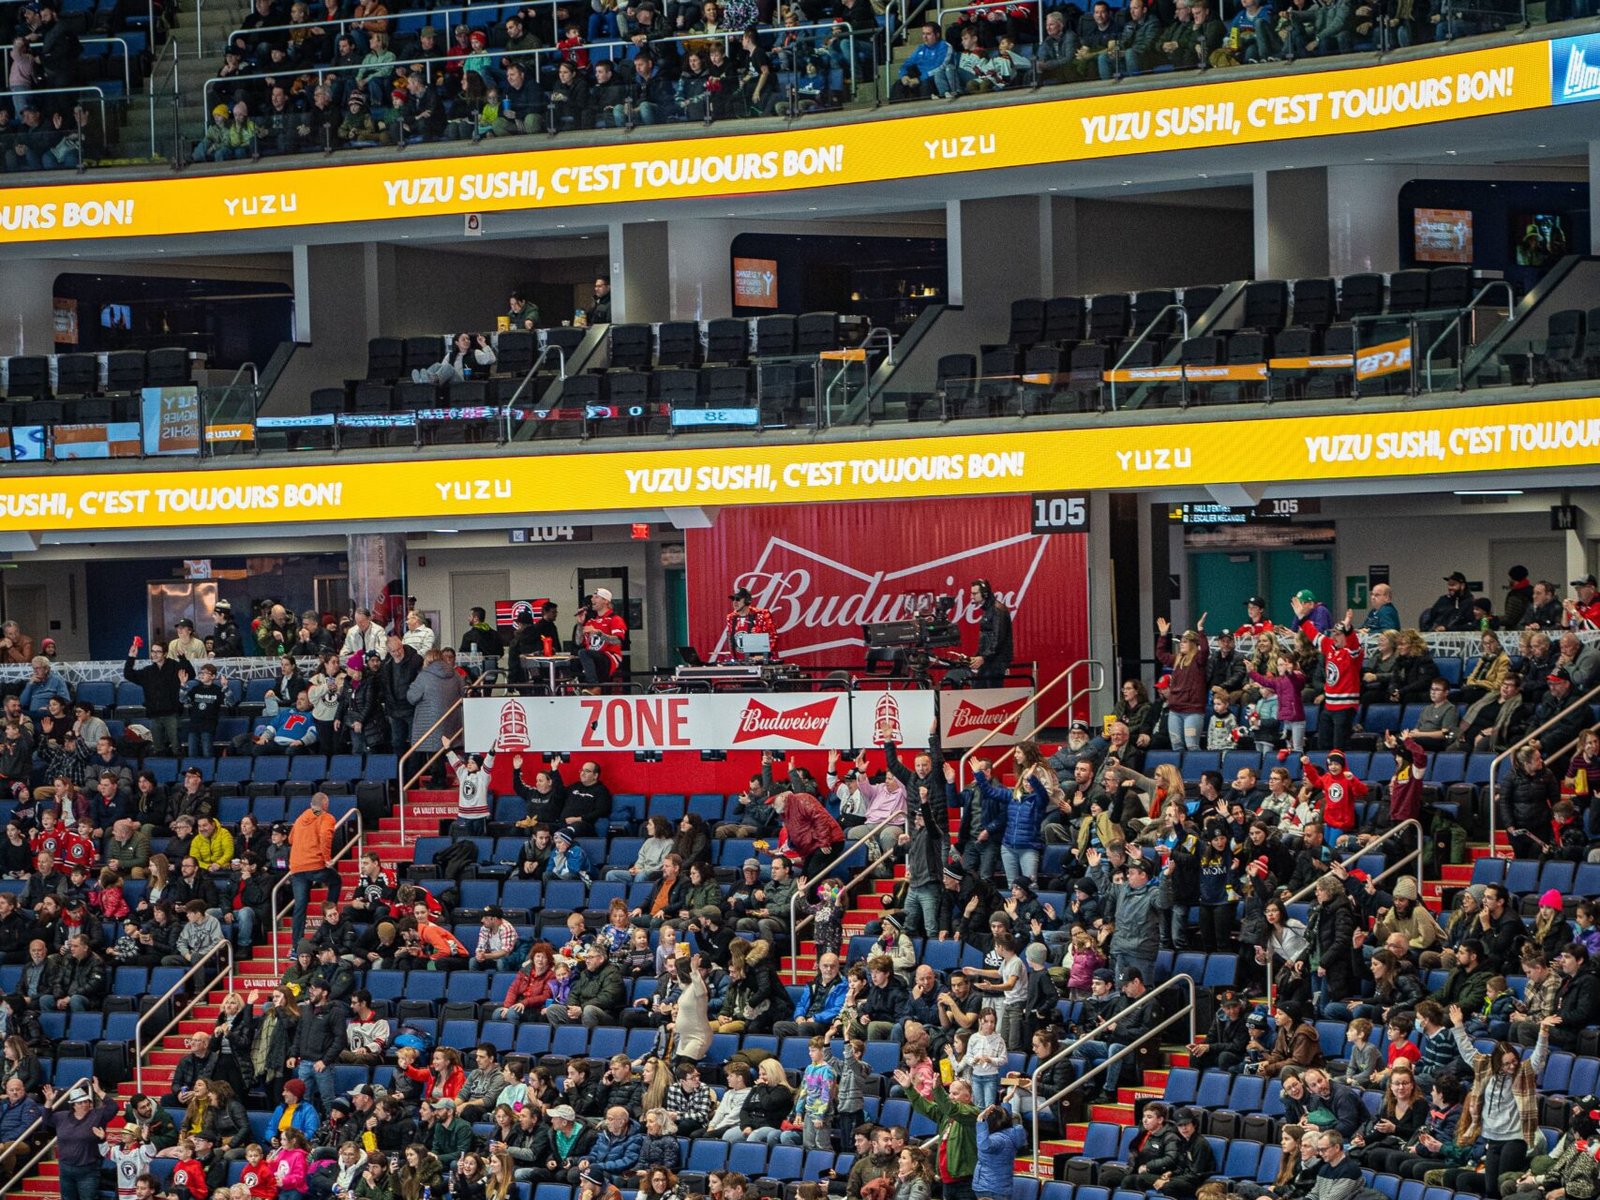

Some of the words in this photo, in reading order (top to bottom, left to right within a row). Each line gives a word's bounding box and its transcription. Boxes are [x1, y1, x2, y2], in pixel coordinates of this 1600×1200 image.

[1080, 111, 1152, 145] YUZU
[1154, 101, 1242, 137] SUSHI,
[1246, 92, 1324, 128] C'EST
[1327, 75, 1453, 120] TOUJOURS
[1456, 66, 1515, 102] BON!
[924, 134, 996, 159] YUZU
[383, 176, 455, 206] YUZU
[459, 169, 545, 202] SUSHI,
[550, 163, 627, 194] C'EST
[630, 152, 779, 188] TOUJOURS
[782, 145, 845, 177] BON!
[0, 203, 57, 231] URS
[62, 199, 135, 227] BON!
[224, 194, 297, 216] YUZU
[1304, 433, 1373, 463] YUZU
[1375, 429, 1446, 461] SUSHI,
[1448, 424, 1505, 456] C'EST
[624, 466, 693, 494] YUZU
[695, 463, 778, 493] SUSHI,
[782, 461, 847, 488] C'EST
[847, 454, 965, 485] TOUJOURS
[967, 451, 1025, 479] BON!
[1116, 447, 1192, 471] YUZU
[79, 489, 151, 515] C'EST
[154, 484, 280, 513] TOUJOURS
[283, 481, 343, 508] BON!
[435, 479, 512, 501] YUZU
[1035, 498, 1086, 527] 105
[1273, 500, 1298, 514] 105
[530, 526, 574, 542] 104
[580, 698, 691, 748] ZONE
[740, 708, 830, 732] Budweiser
